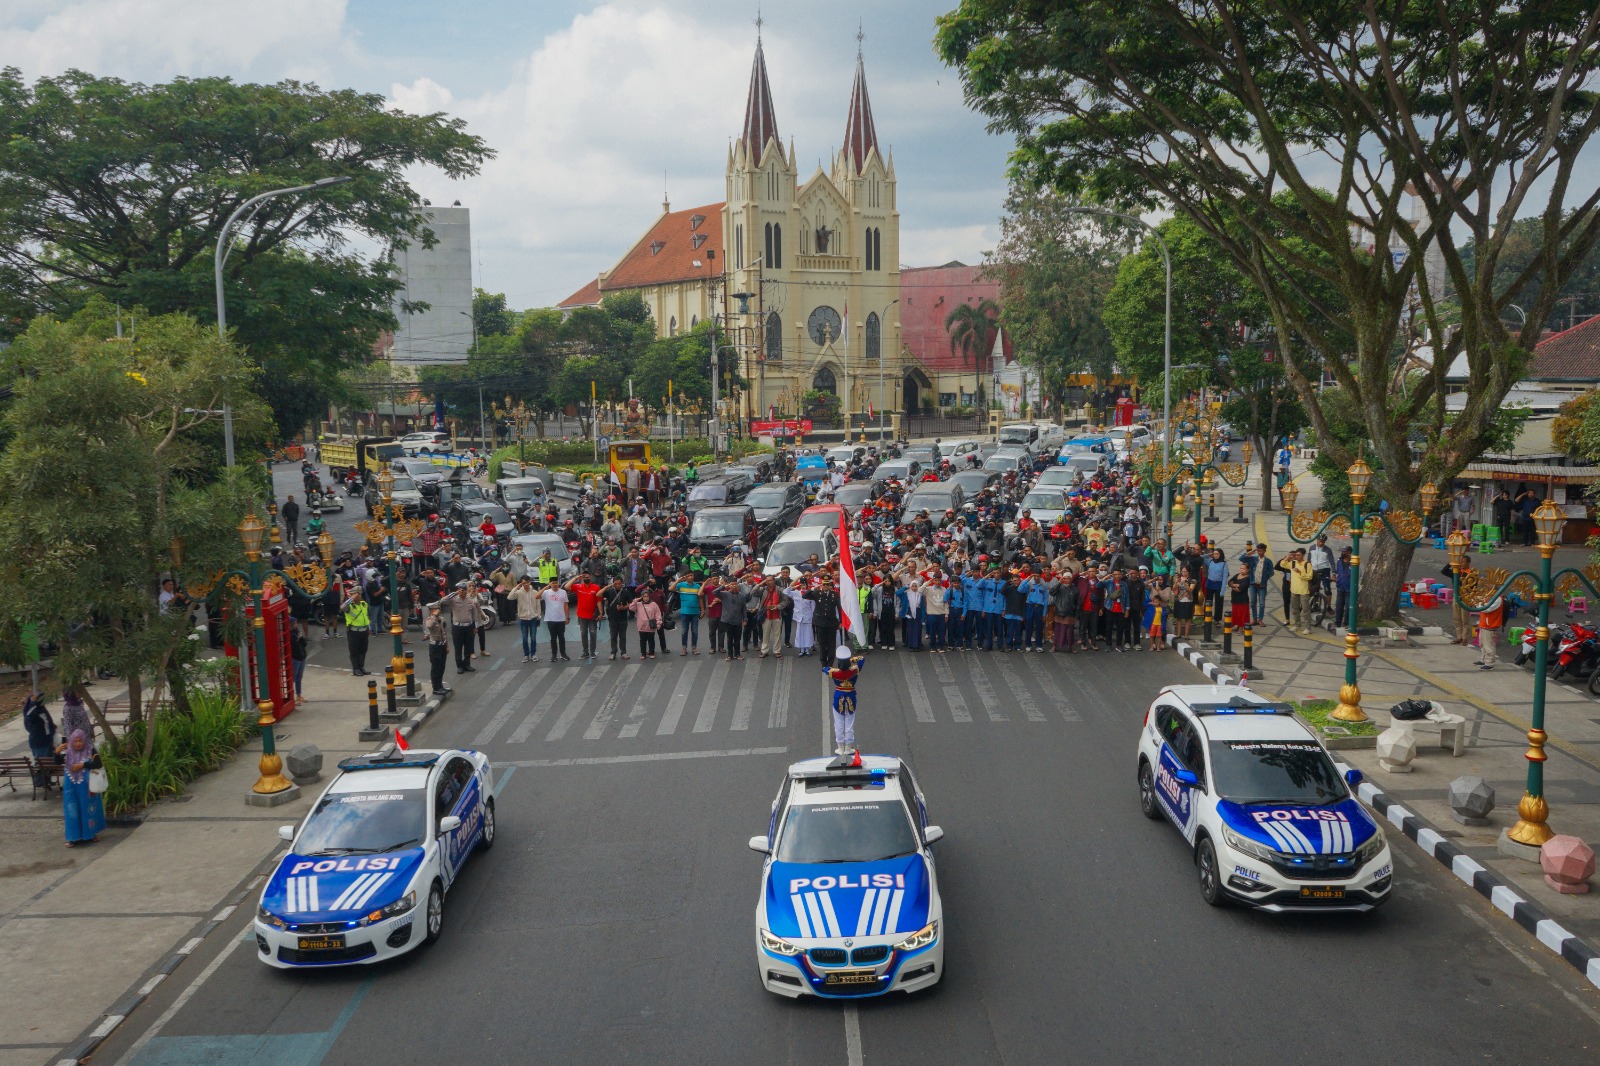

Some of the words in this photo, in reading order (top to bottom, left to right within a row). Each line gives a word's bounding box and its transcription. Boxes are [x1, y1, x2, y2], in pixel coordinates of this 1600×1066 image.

[1158, 763, 1181, 802] POLISI
[1251, 809, 1349, 823] POLISI
[456, 801, 481, 850] POLISI
[291, 858, 400, 874] POLISI
[1234, 865, 1261, 881] POLICE
[1373, 865, 1391, 879] POLICE
[790, 874, 904, 893] POLISI
